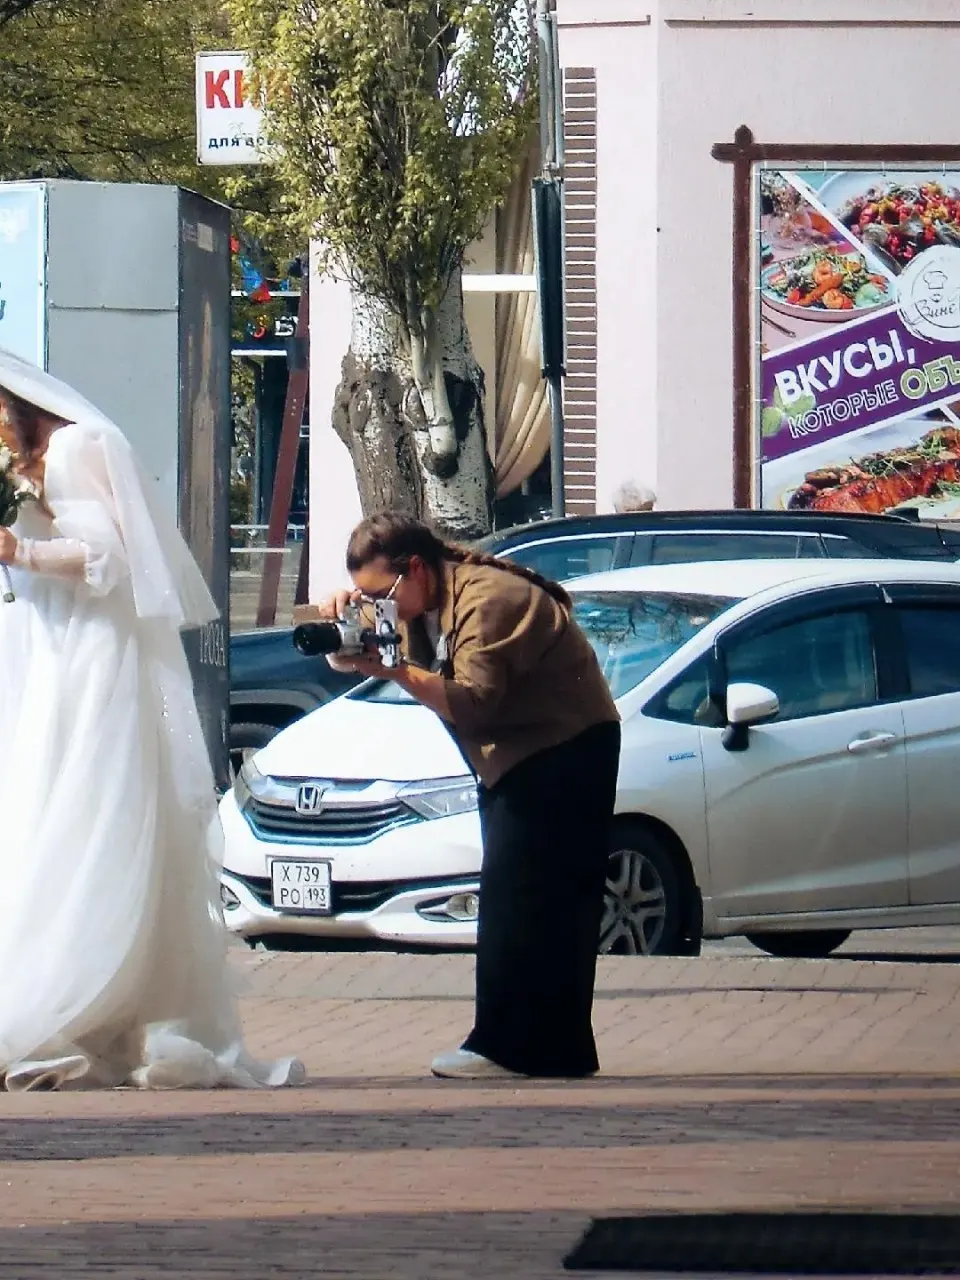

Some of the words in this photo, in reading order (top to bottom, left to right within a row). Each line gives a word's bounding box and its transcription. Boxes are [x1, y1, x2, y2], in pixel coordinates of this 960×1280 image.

[774, 329, 916, 406] ВКУСЫ,
[788, 380, 899, 439] КОТОРЫЕ
[295, 866, 320, 883] 739
[307, 888, 326, 901] 193
